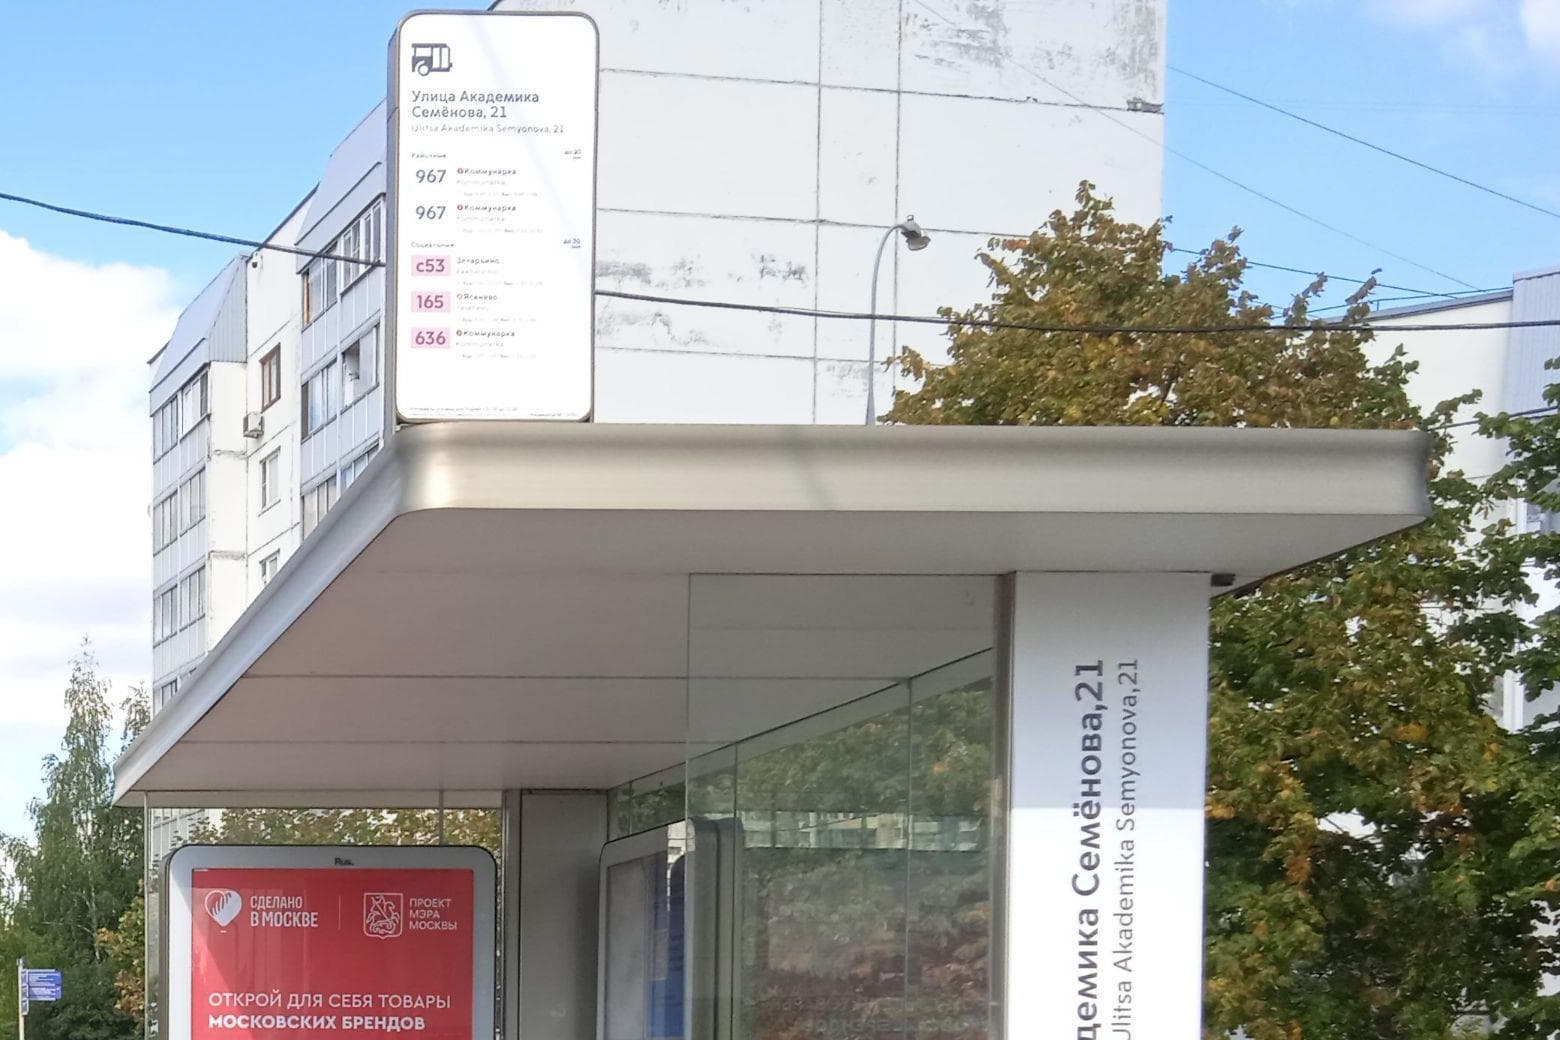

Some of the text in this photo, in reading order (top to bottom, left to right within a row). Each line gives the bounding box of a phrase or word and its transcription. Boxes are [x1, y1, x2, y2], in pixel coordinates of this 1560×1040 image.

[412, 90, 540, 104] Улица Академика
[412, 106, 507, 120] Семёнова, 21
[415, 169, 447, 183] 967
[415, 206, 447, 220] 967
[416, 259, 445, 273] с53
[417, 295, 444, 309] 165
[415, 331, 447, 345] 636
[250, 895, 303, 909] СДЕЛАНО
[409, 898, 452, 908] ПРОЕКТ
[1112, 839, 1136, 973] Akademika
[250, 911, 319, 928] В МОСКВЕ
[409, 909, 441, 919] МЭРА
[409, 920, 458, 931] МОСКВЫ
[208, 989, 451, 1009] ОТКРОЙ ДЛЯ СЕБЯ ТОВАРЫ
[208, 1013, 425, 1032] МОСКОВСКИХ БРЕНДОВ
